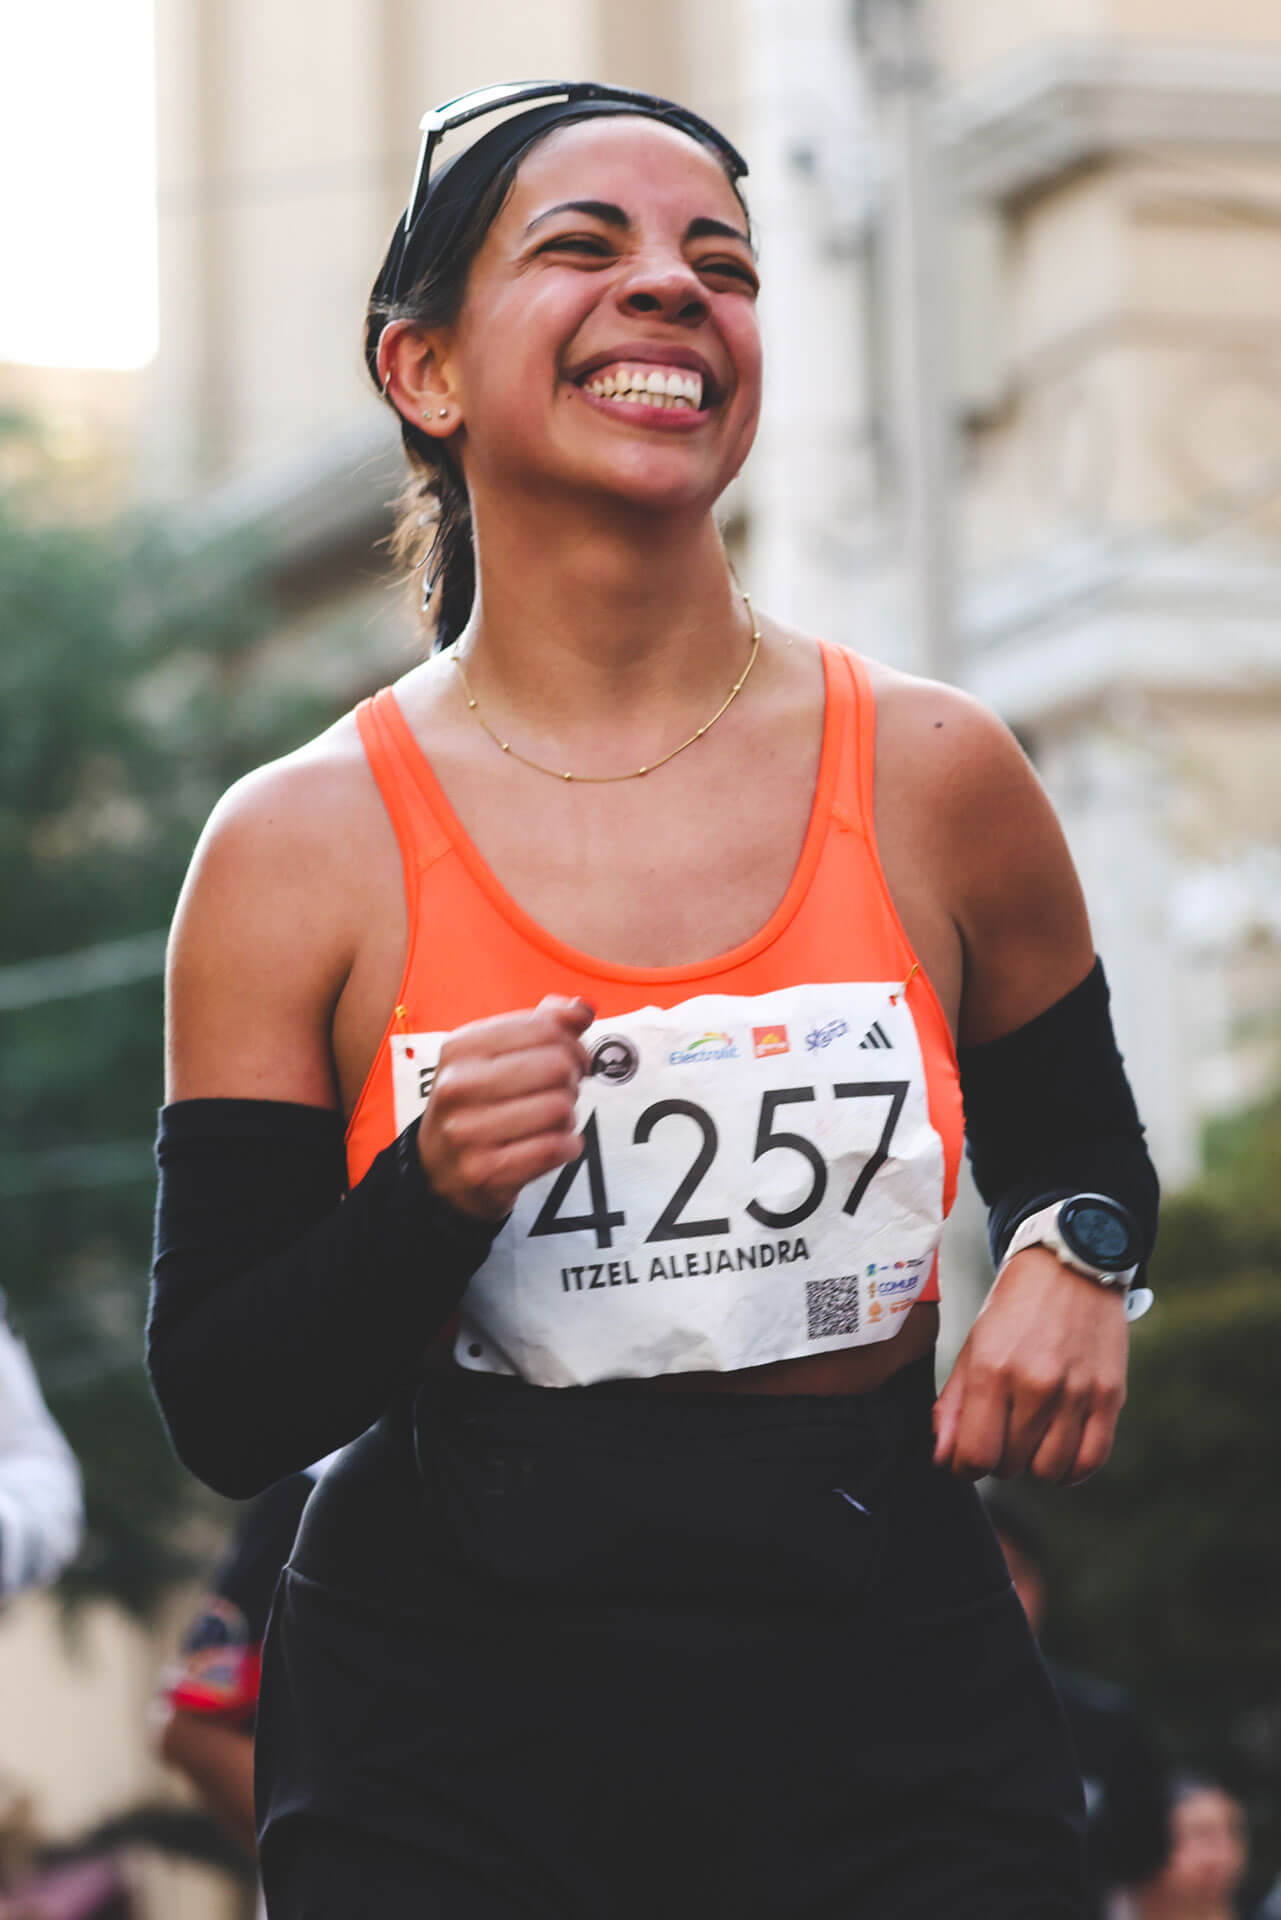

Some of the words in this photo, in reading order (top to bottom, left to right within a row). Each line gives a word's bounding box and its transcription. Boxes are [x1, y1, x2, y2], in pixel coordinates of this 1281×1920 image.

[528, 1081, 910, 1249] 4257
[561, 1260, 639, 1292] ITZEL
[648, 1237, 809, 1282] ALEJANDRA
